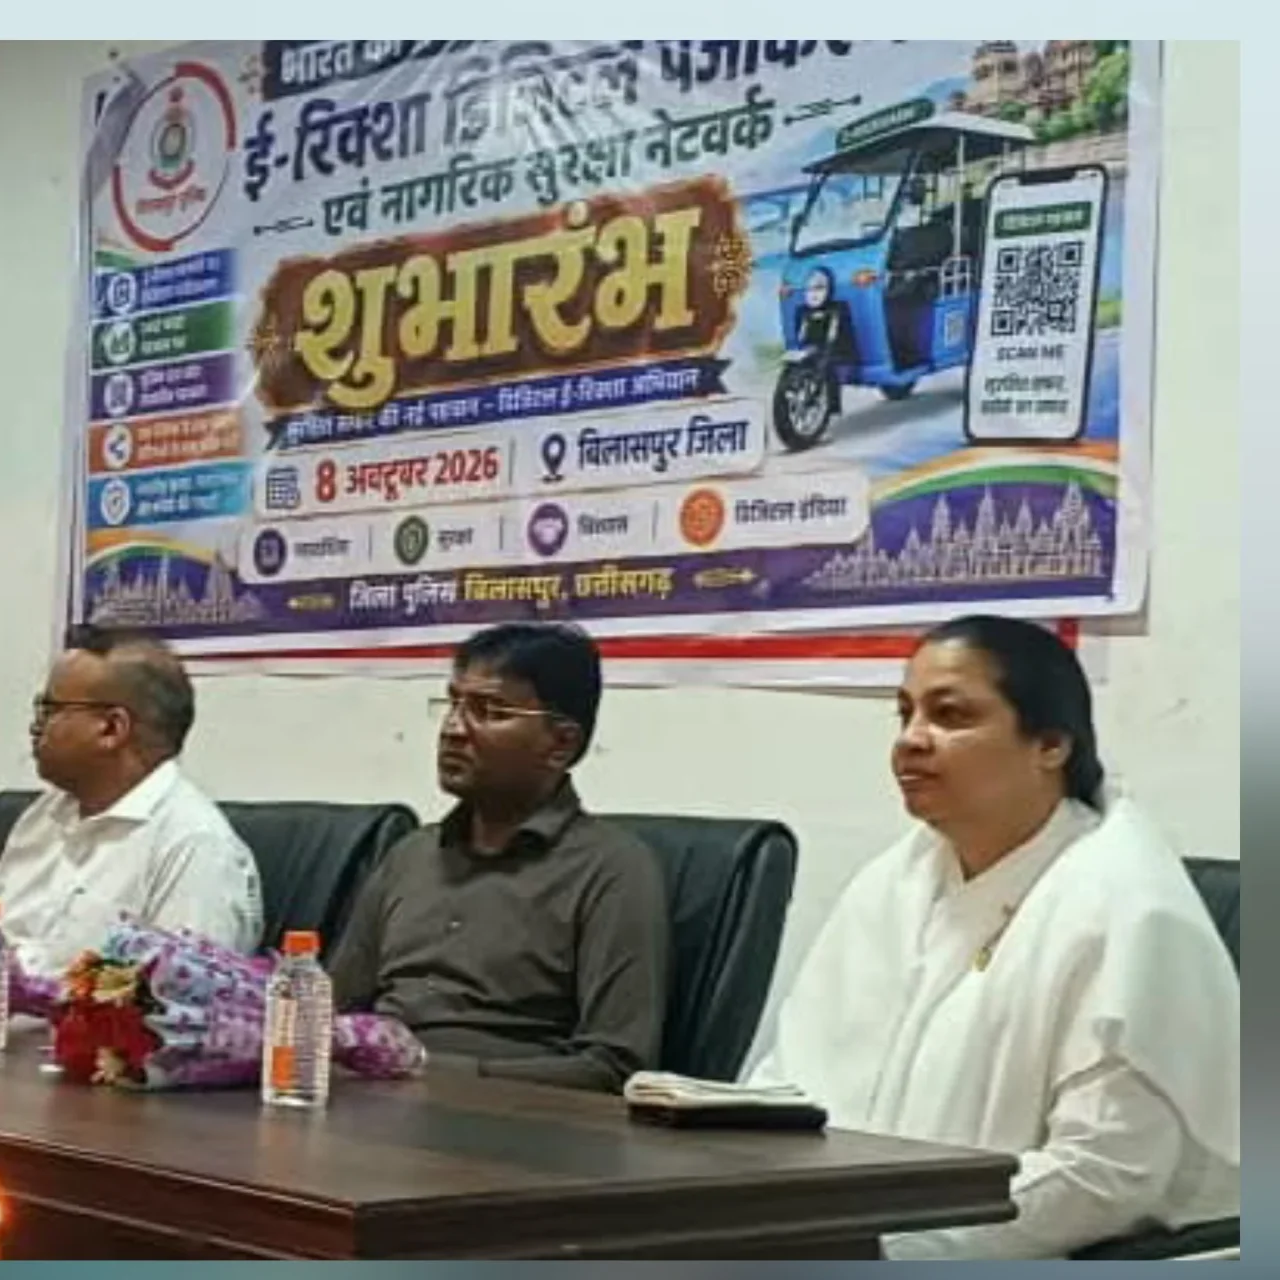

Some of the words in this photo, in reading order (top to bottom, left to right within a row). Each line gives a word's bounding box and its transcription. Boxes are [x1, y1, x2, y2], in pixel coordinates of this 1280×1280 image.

[244, 92, 431, 201] ई-रिक्शा
[323, 176, 374, 236] एवं
[381, 153, 517, 224] नागरिक
[525, 130, 637, 206] सुरक्षा
[643, 83, 776, 169] नेटवर्क
[295, 200, 701, 409] शुभारंभ
[316, 457, 337, 502] 8
[434, 447, 499, 486] 2026
[578, 427, 683, 474] बिलासपुर
[686, 415, 752, 458] जिला
